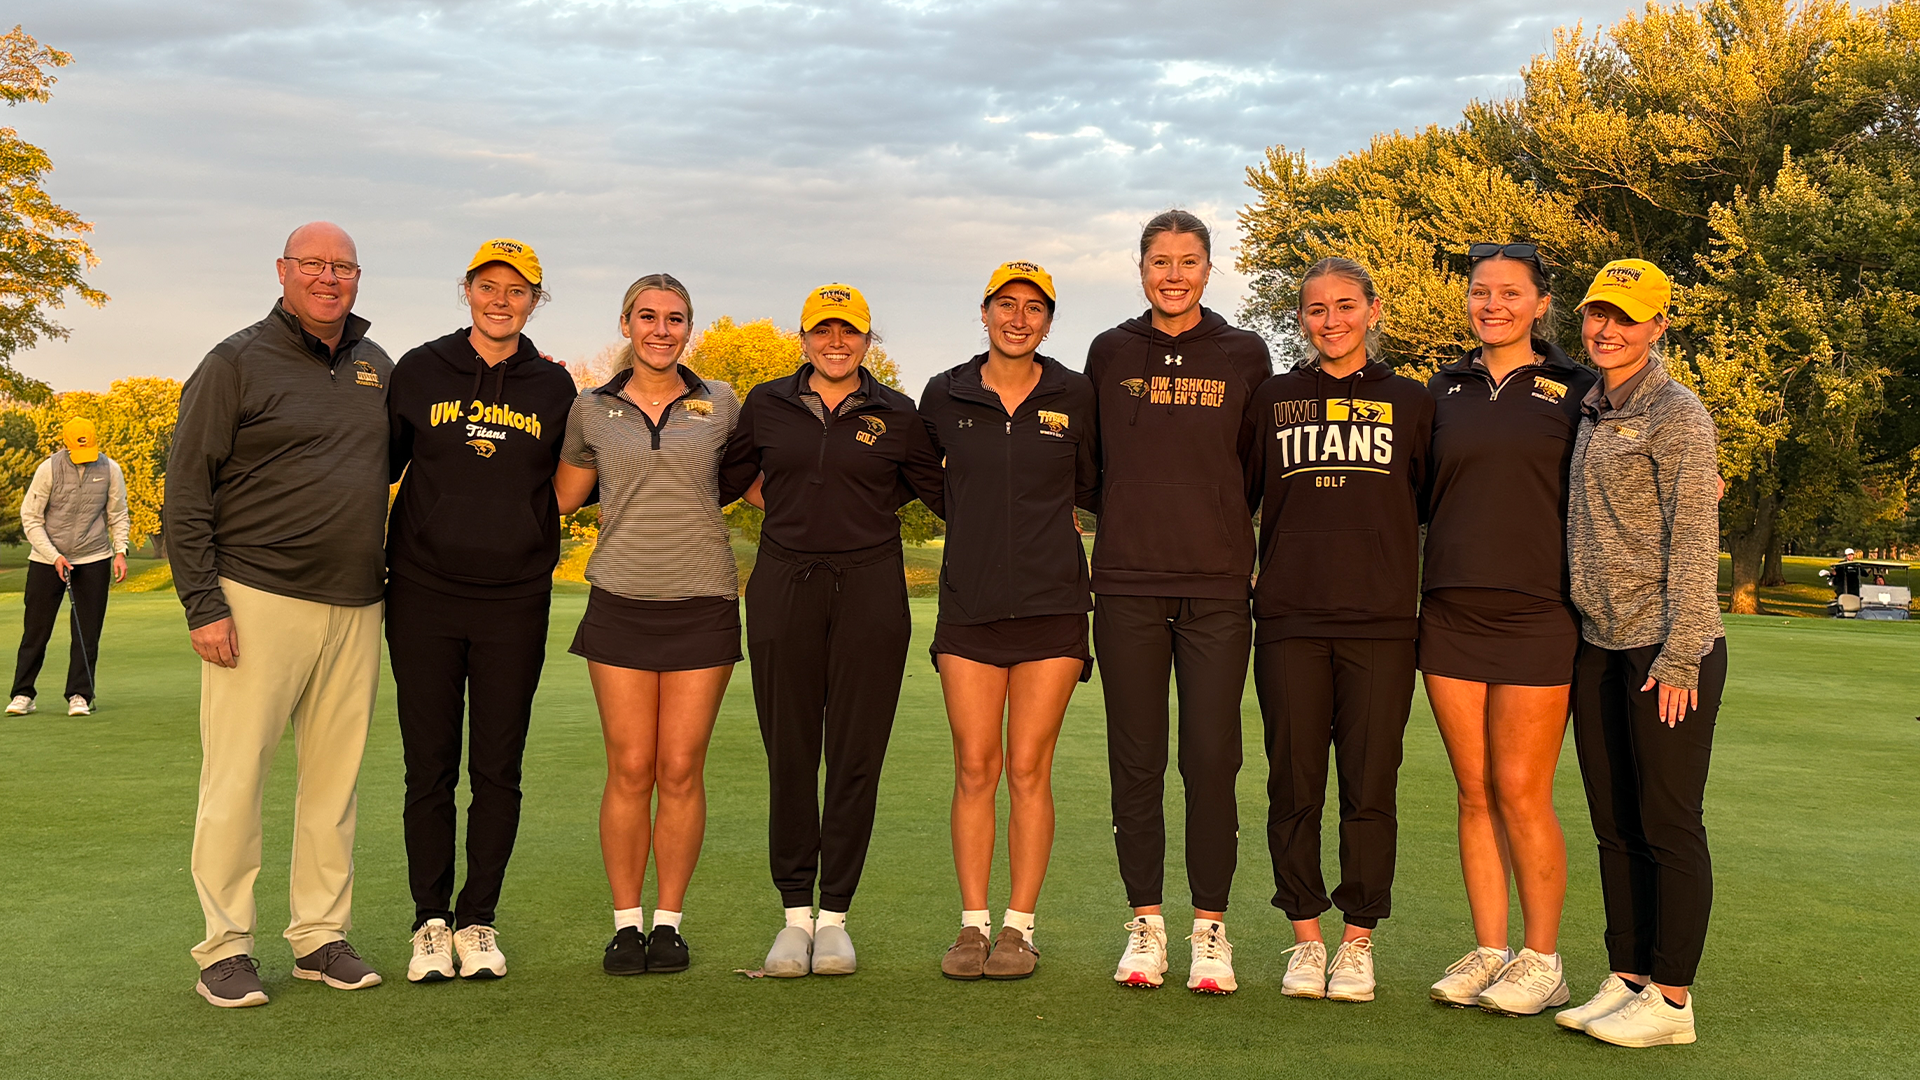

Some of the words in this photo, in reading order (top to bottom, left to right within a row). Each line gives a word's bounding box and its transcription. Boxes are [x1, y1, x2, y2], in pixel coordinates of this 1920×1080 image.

[1150, 376, 1226, 394] UW-OSHKOSH
[1150, 390, 1198, 406] WOMEN'S
[1200, 393, 1224, 408] GOLF
[1274, 399, 1320, 428] UWO
[466, 424, 507, 440] Titans
[856, 431, 877, 446] GOLF
[1276, 424, 1393, 468] TITANS
[1315, 476, 1347, 488] GOLF
